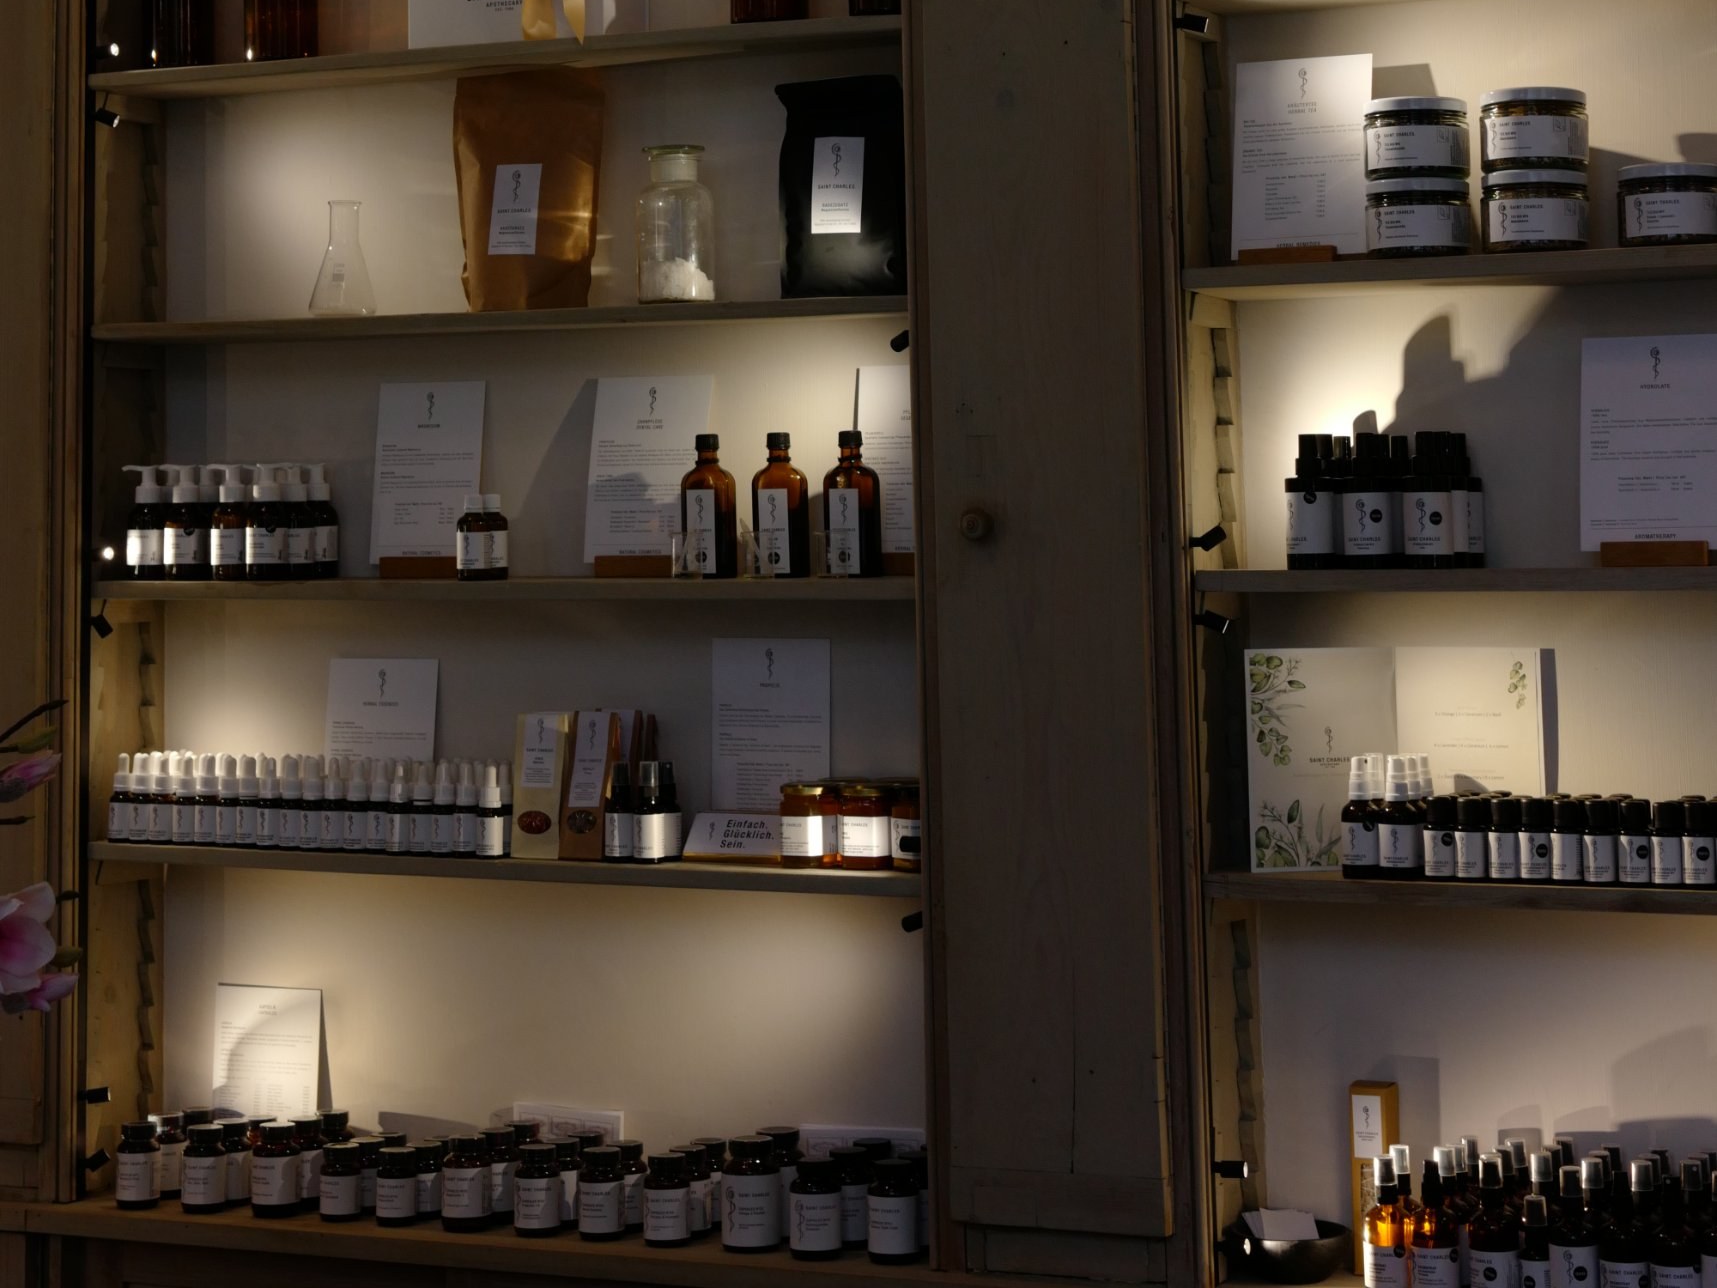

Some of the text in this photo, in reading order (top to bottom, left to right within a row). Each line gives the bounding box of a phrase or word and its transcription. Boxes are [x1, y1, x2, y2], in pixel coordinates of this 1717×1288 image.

[726, 820, 768, 830] Einfach.
[723, 829, 774, 840] Glücklich.
[720, 840, 746, 849] Sein.
